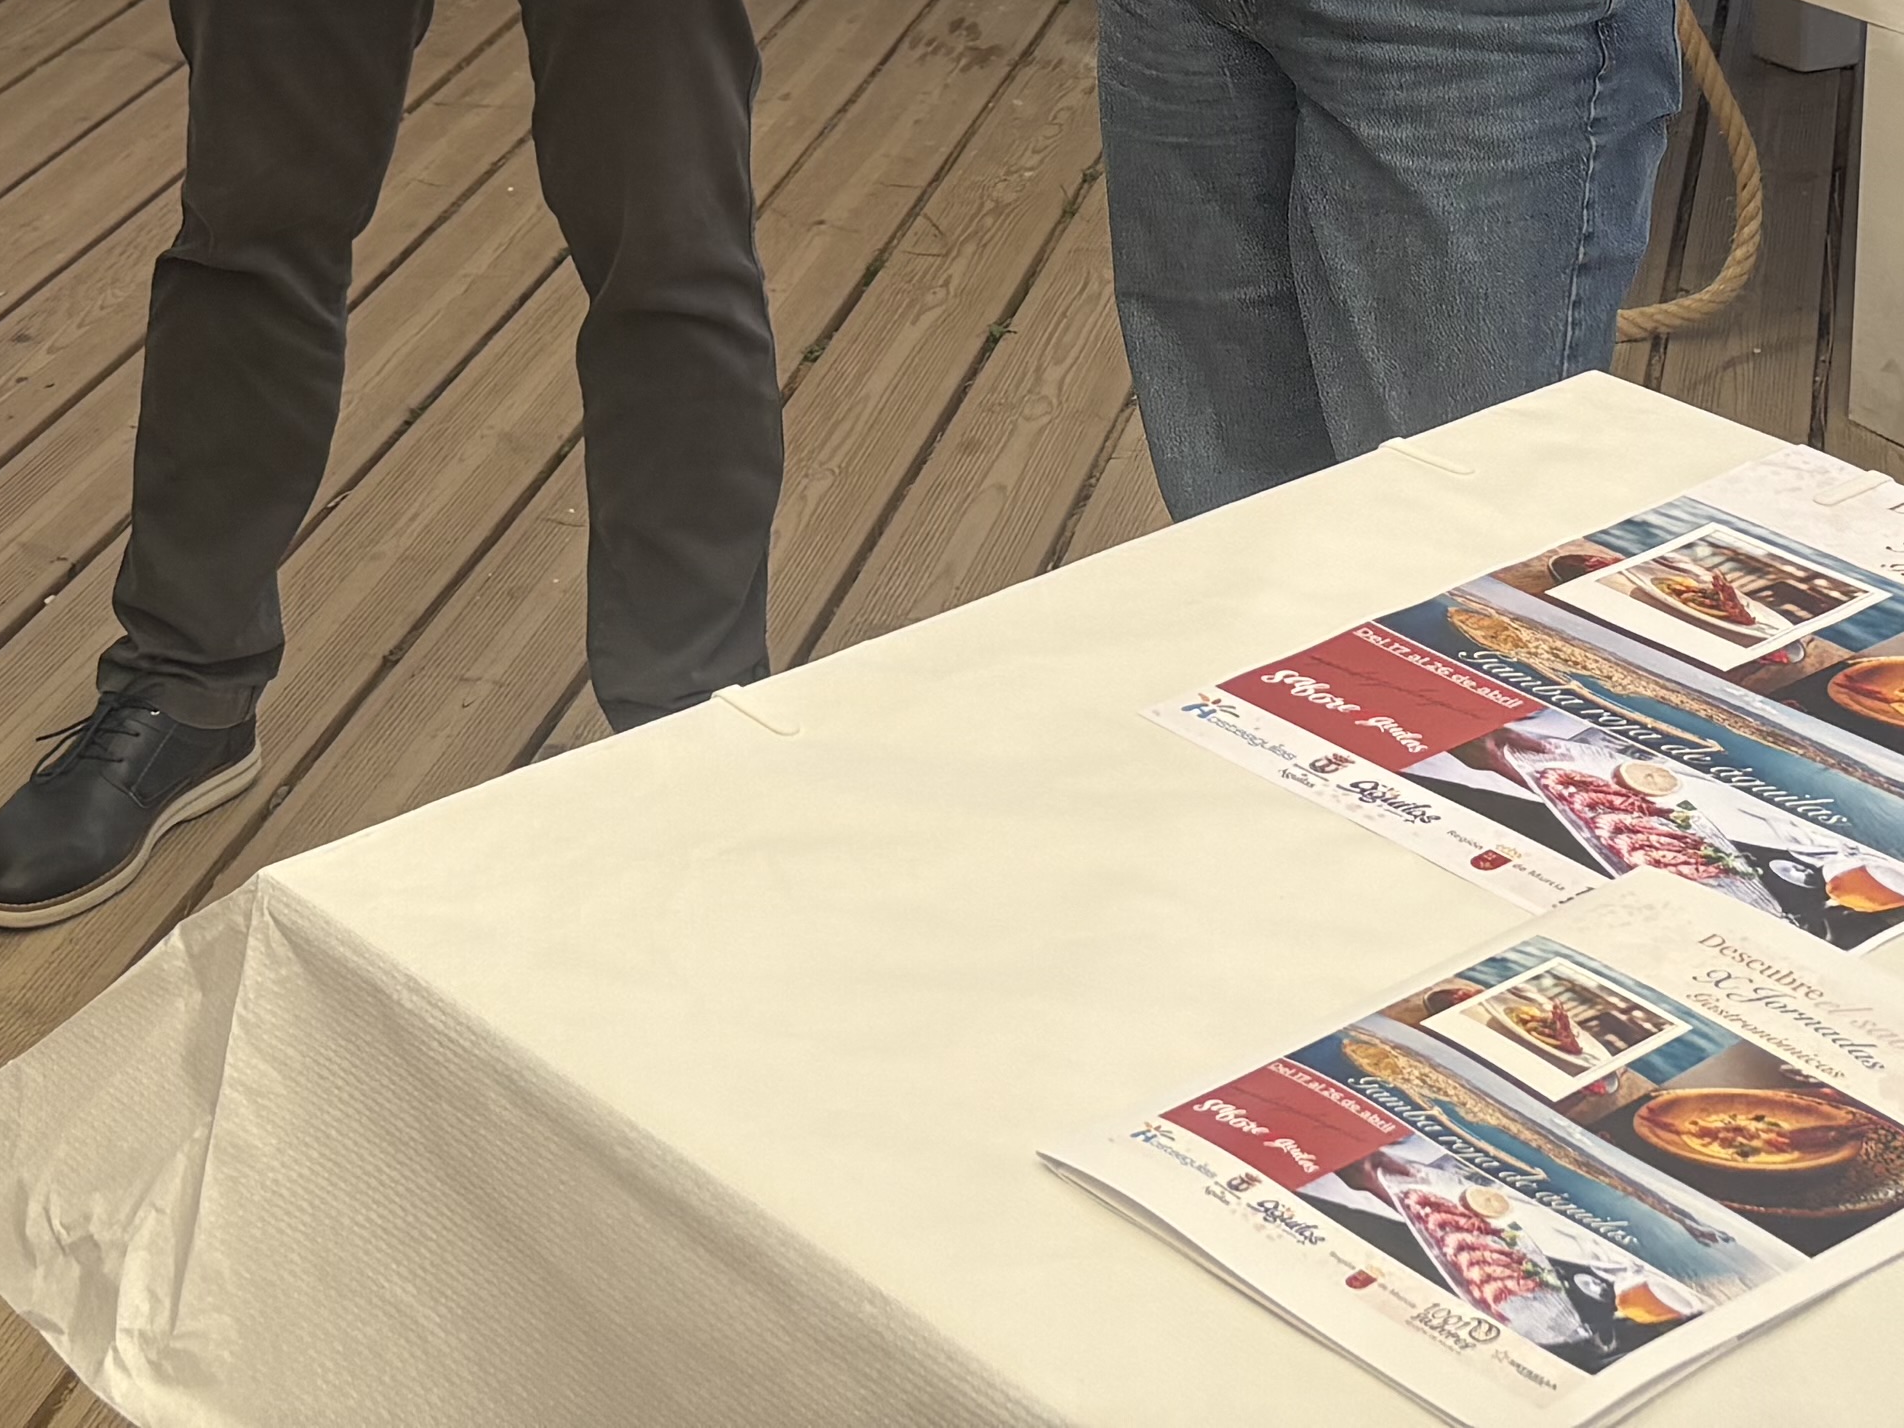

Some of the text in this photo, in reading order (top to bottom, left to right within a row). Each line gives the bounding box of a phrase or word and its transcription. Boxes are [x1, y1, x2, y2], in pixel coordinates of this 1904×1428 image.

[1354, 627, 1390, 646] Del
[1408, 653, 1429, 666] al
[1451, 674, 1476, 689] de
[1476, 686, 1523, 709] abril
[1458, 648, 1582, 711] Gamba
[1580, 707, 1663, 744] roja
[1661, 741, 1713, 766] de
[1697, 933, 1824, 1001] Descubre
[1726, 986, 1885, 1071] Jornadas
[1347, 1075, 1443, 1133] Gamba
